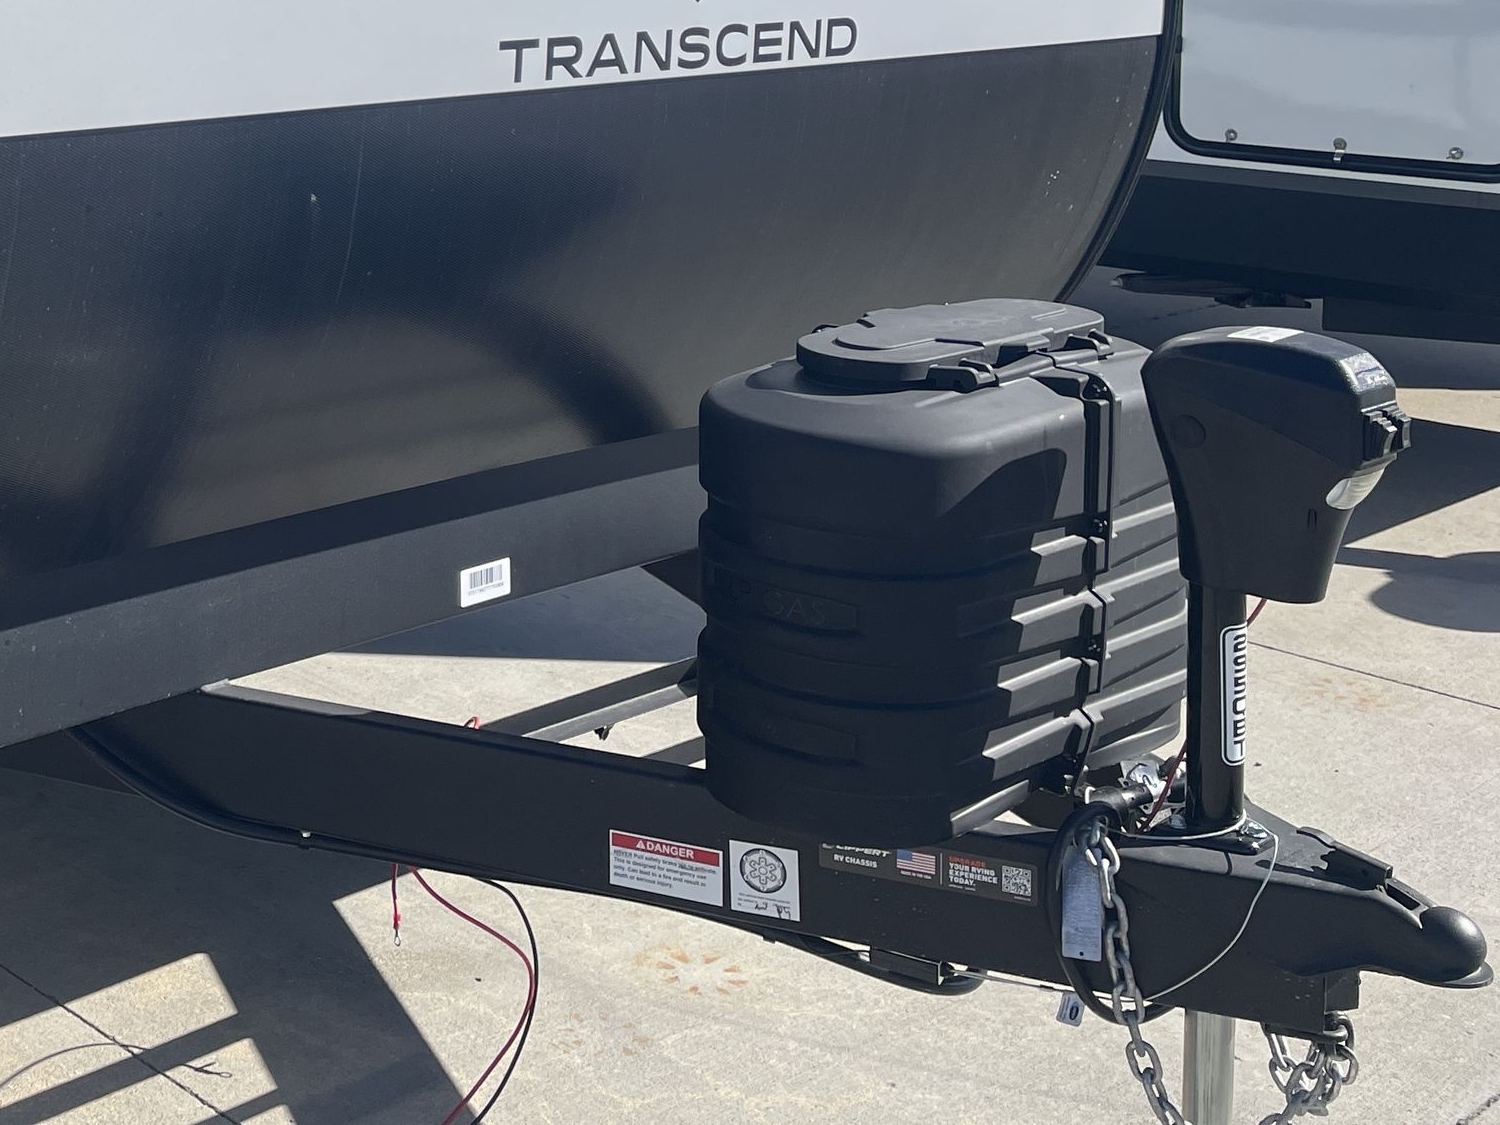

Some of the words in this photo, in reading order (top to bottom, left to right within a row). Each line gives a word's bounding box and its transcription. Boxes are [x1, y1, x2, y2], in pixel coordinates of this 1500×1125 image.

[499, 16, 858, 83] TRANSCEND
[646, 841, 695, 859] DANGER
[833, 853, 845, 862] RV
[845, 856, 878, 869] CHASSIS
[949, 862, 970, 872] YOUR
[949, 869, 998, 884] EXPERIENCE
[949, 876, 977, 887] TODAY.
